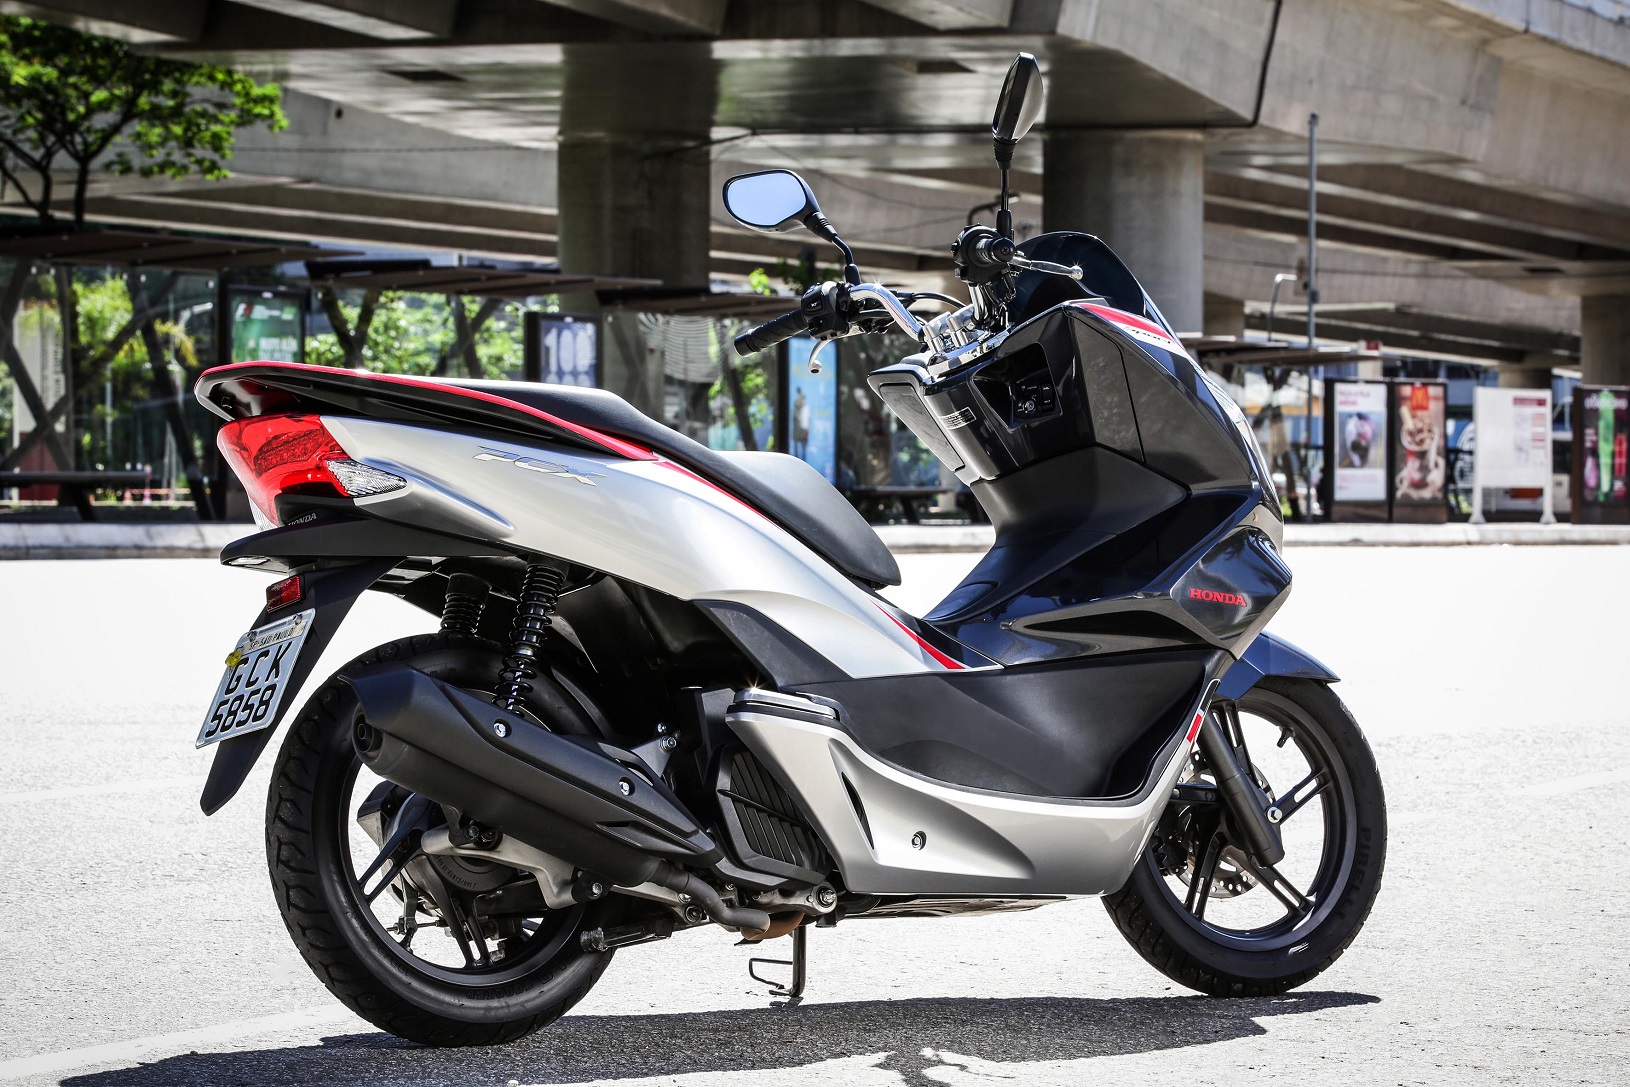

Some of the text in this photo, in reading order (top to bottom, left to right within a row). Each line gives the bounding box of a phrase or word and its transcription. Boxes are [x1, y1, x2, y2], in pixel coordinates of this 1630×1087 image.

[473, 446, 607, 486] PCX
[1189, 587, 1247, 607] HONDA
[225, 641, 293, 695] GCK
[205, 683, 277, 738] 5858
[1337, 827, 1372, 920] PIRELLI
